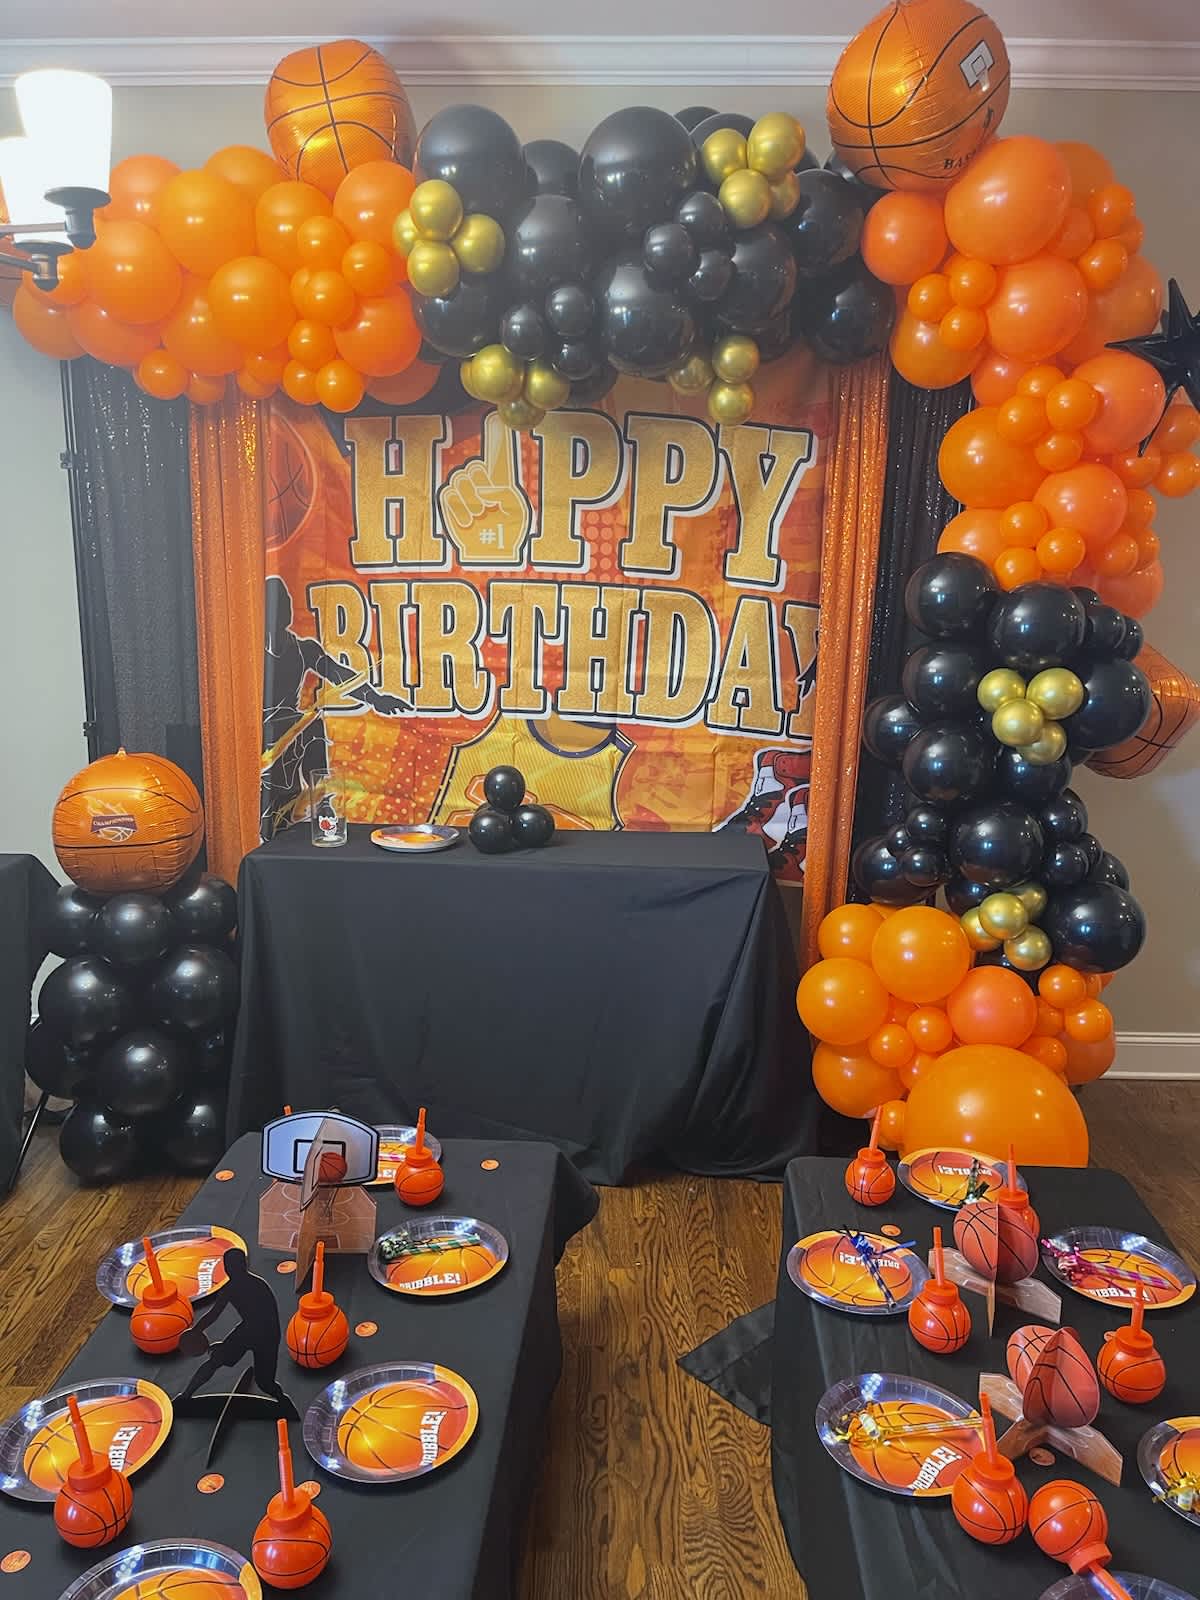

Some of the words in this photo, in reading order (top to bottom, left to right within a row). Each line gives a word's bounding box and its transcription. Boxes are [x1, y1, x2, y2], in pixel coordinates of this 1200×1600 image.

[341, 408, 816, 590] HPPY
[479, 523, 504, 549] #1
[839, 1251, 900, 1269] DRIBLE!
[108, 1425, 144, 1472] IBBLE!
